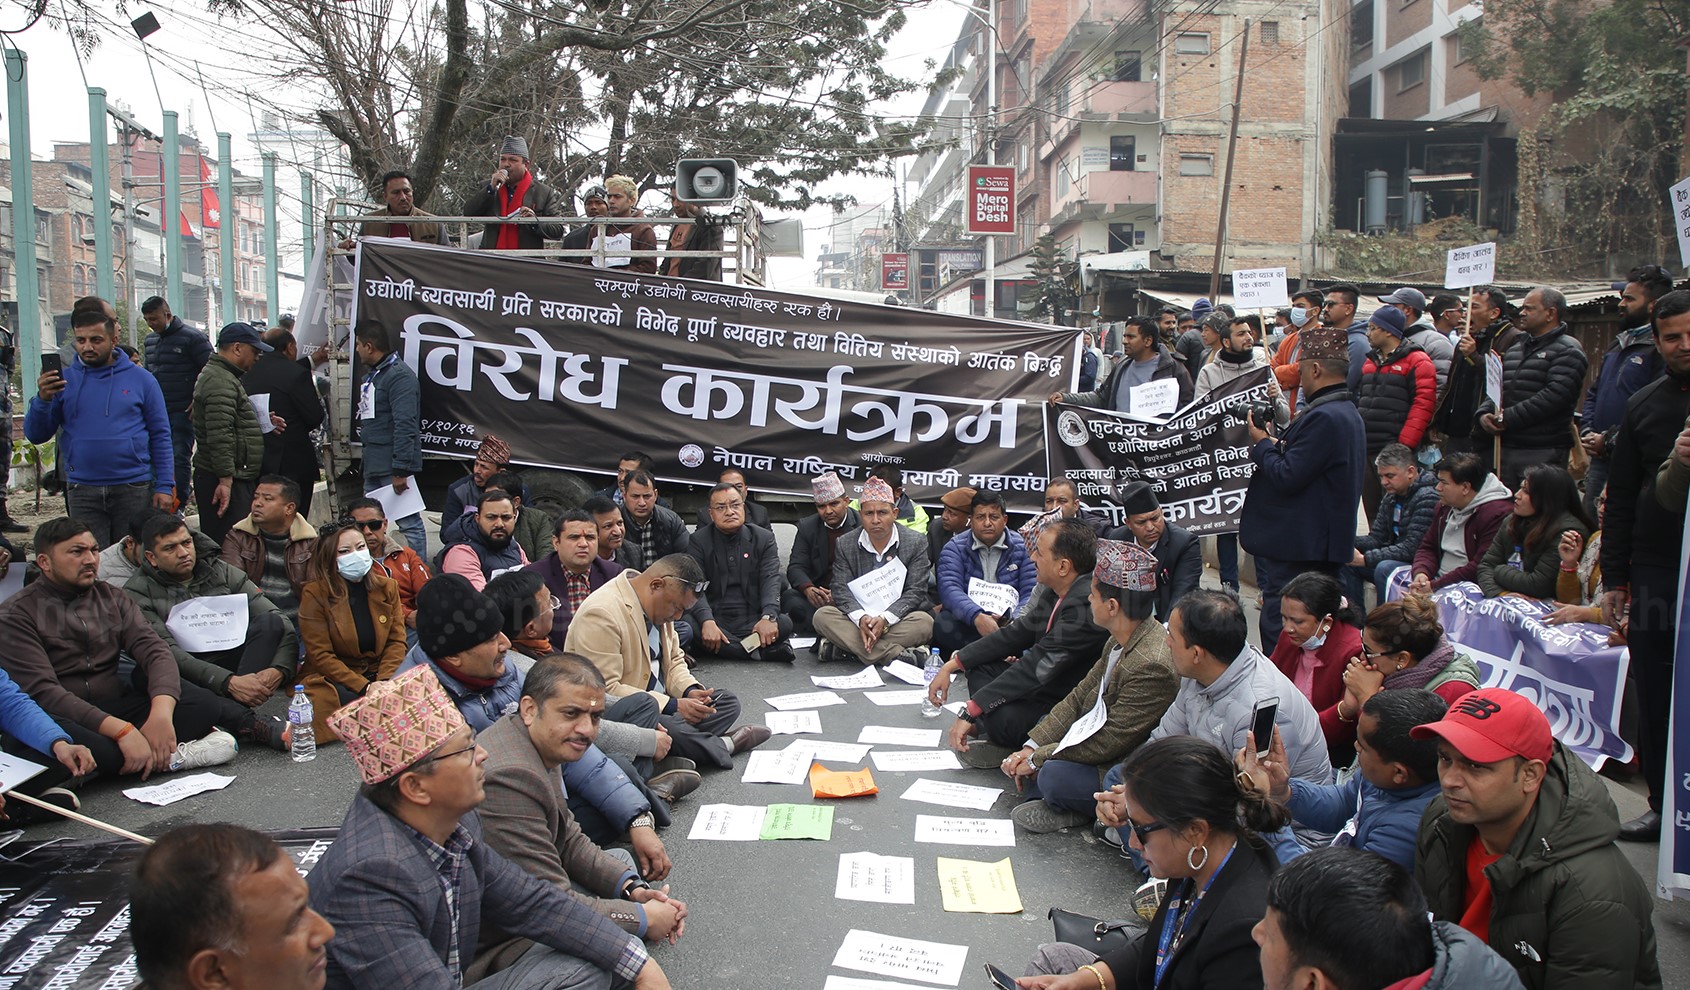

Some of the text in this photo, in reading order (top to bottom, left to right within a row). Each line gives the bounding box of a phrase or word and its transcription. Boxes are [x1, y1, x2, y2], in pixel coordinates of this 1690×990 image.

[977, 193, 1008, 204] Mero
[977, 203, 1008, 214] Digital
[977, 211, 1008, 222] Desh
[595, 278, 640, 298] सम्पूर्ण
[644, 282, 687, 301] उद्योगी
[783, 300, 813, 317] एक
[501, 291, 533, 316] प्रति
[539, 302, 623, 326] सरकारको
[636, 306, 681, 336] विभेद
[688, 317, 717, 342] पूर्ण
[793, 331, 827, 352] तथा
[833, 331, 884, 358] वित्तिय
[891, 342, 961, 366] संस्थाको
[967, 351, 1018, 371] आतंक
[400, 314, 1027, 448] विरोध कार्यक्रम
[1088, 418, 1148, 439] फुटवेयर
[1190, 423, 1217, 441] अफ
[713, 446, 776, 471] नेपाल
[969, 472, 1048, 493] महासंघ
[1065, 446, 1249, 480] व्यवसायी प्रति सरकारको विभेद
[1077, 482, 1112, 496] वित्तिय
[1174, 470, 1213, 489] आतंक
